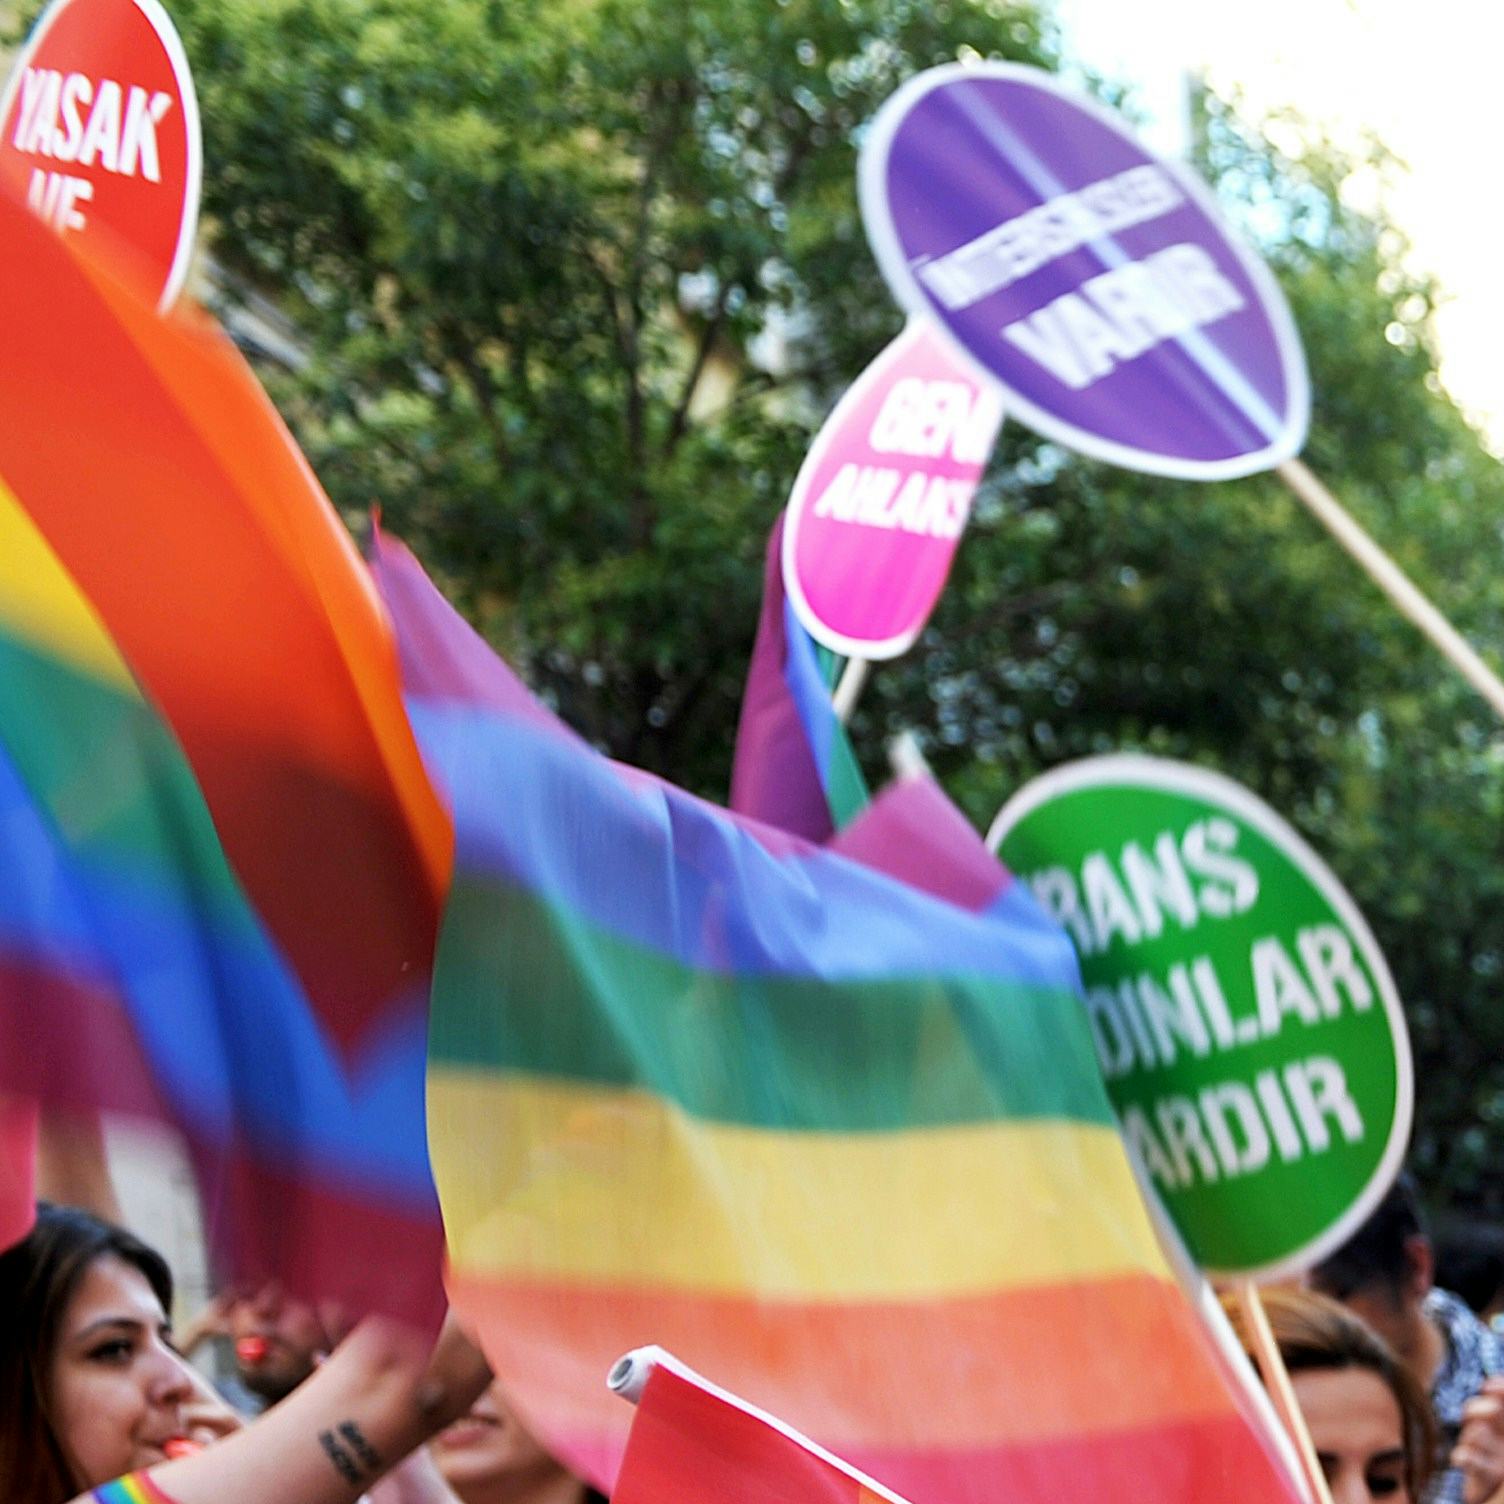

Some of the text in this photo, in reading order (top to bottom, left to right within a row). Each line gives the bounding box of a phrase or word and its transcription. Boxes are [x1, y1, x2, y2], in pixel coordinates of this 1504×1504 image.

[13, 67, 173, 184] YASAK
[869, 376, 1000, 466] GEN
[813, 463, 978, 540] AHLAKS
[1032, 817, 1260, 957] RANS
[1085, 922, 1374, 1078] DINLAR
[1120, 1054, 1366, 1190] ARDIR
